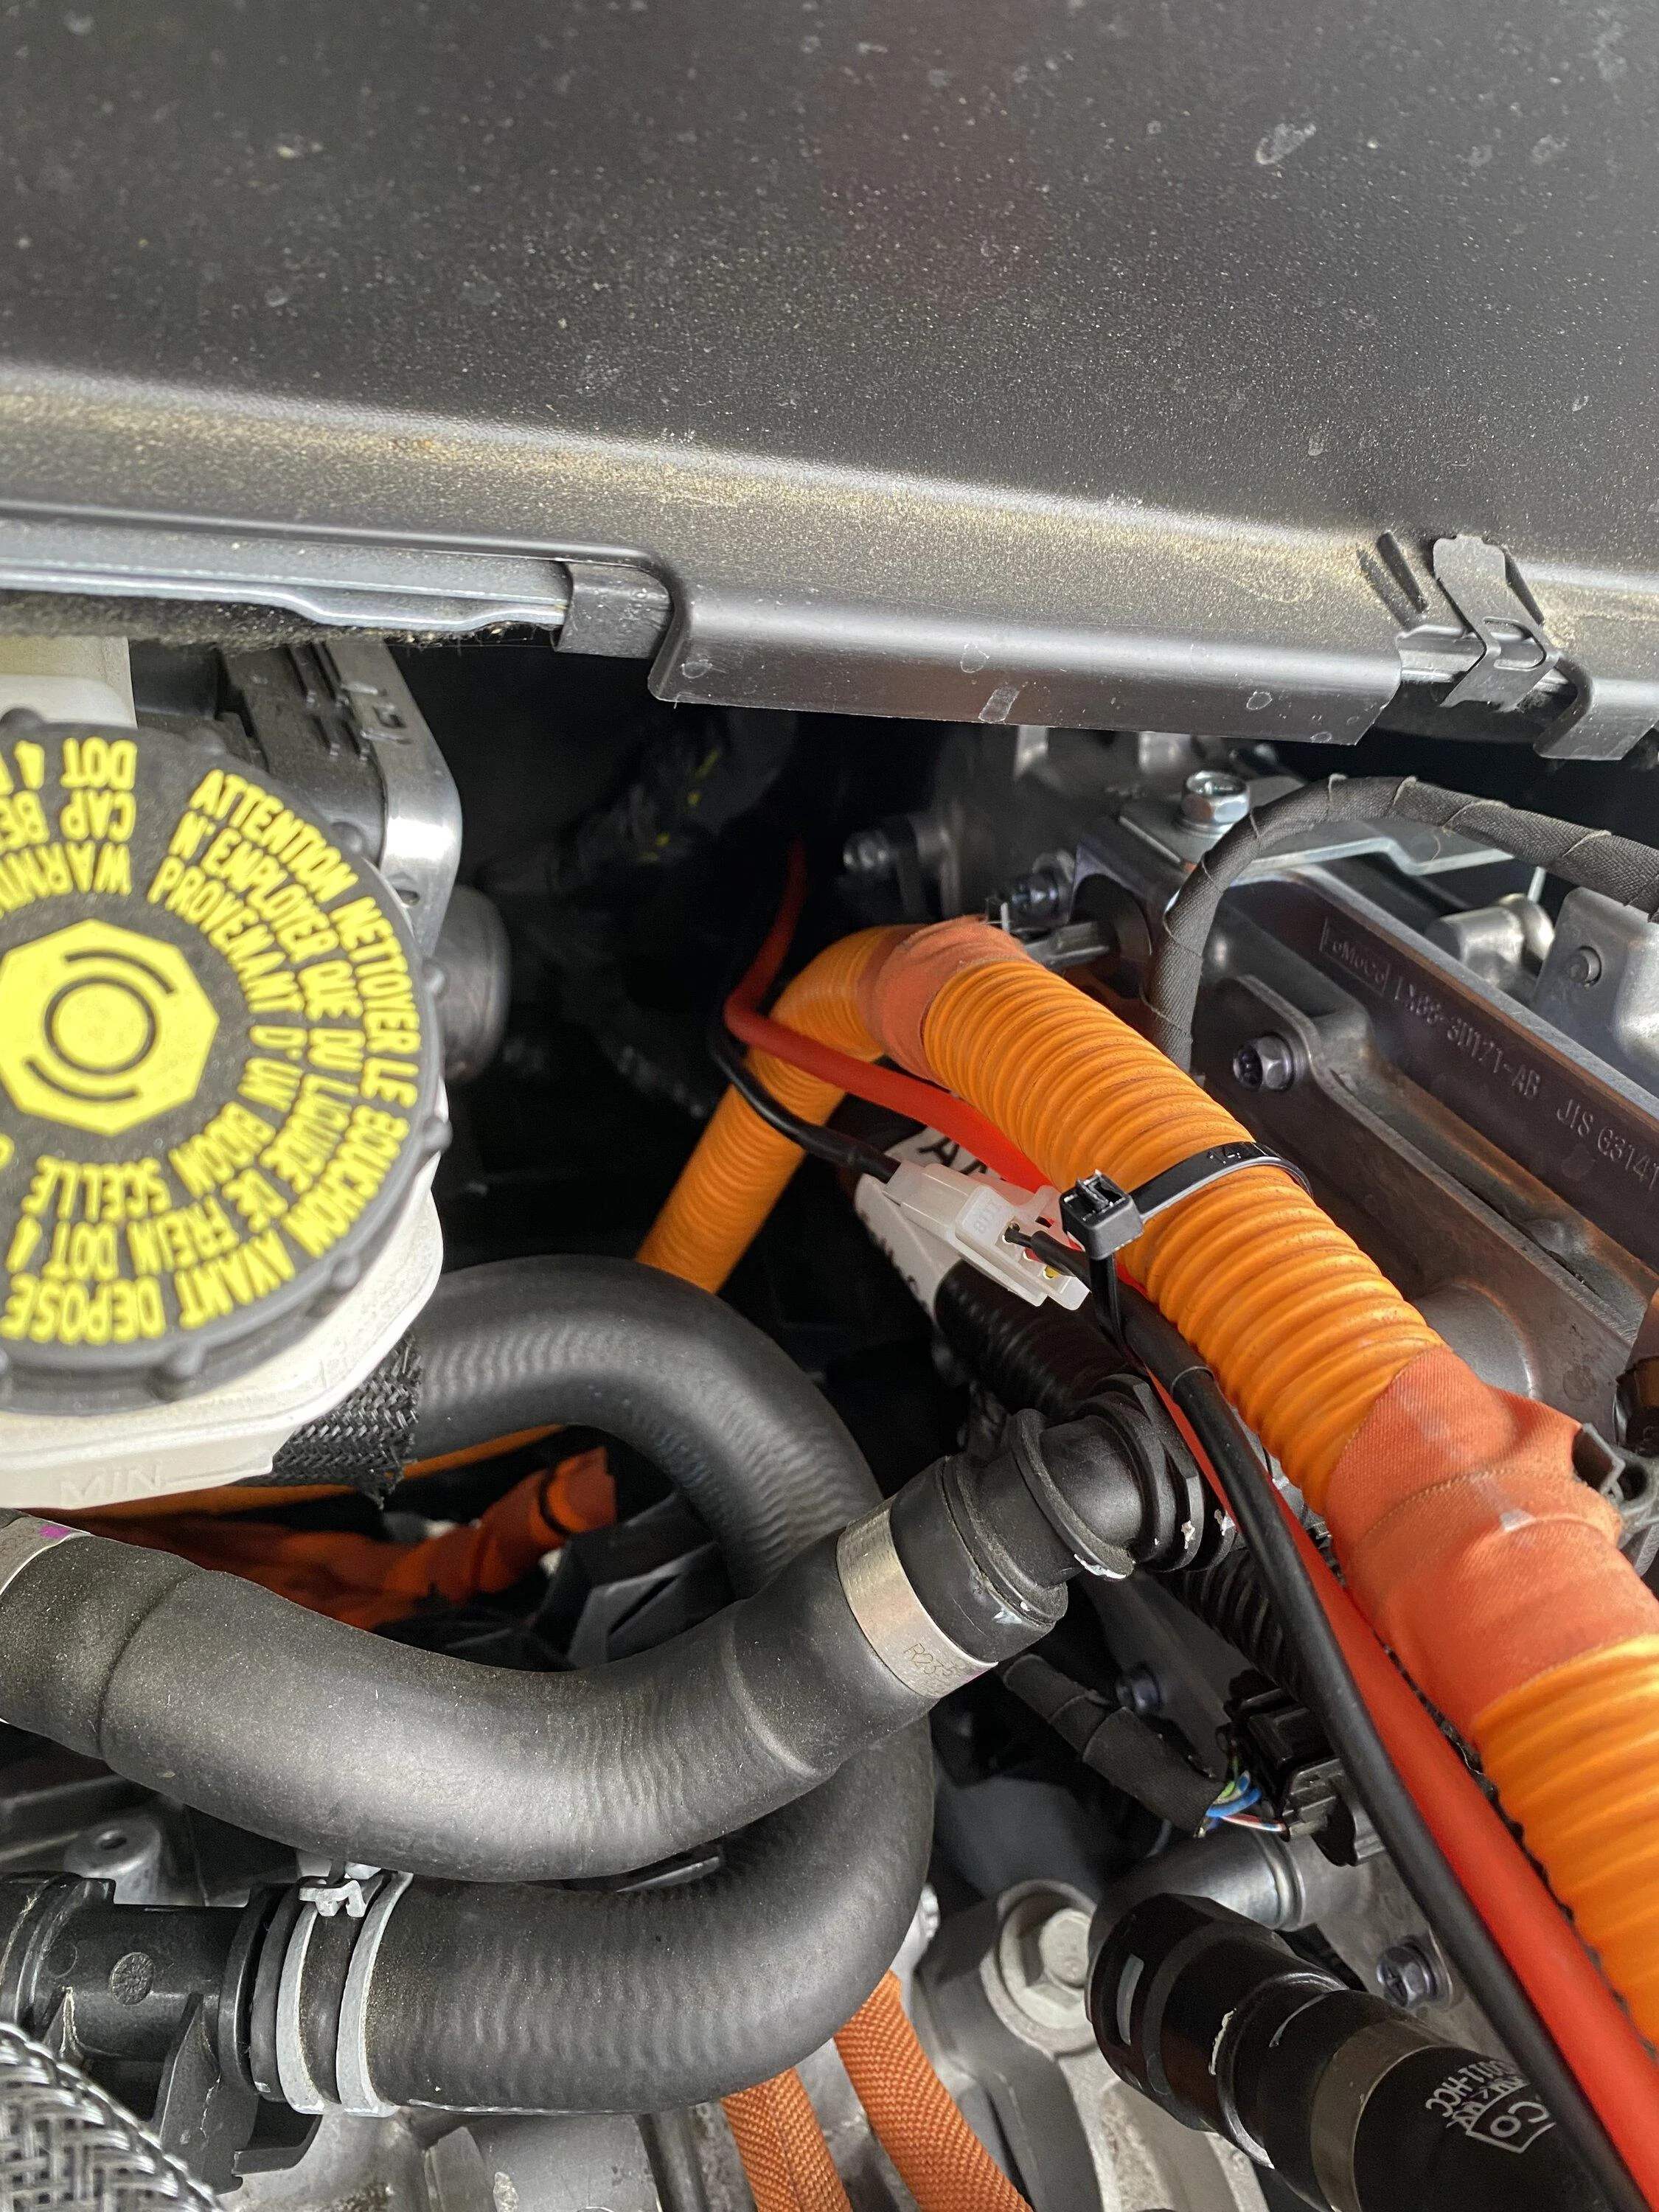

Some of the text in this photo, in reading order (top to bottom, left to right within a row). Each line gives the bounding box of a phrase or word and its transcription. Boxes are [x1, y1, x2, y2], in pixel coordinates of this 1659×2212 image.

[13, 740, 45, 790] 4
[60, 737, 138, 791] DOT
[60, 789, 138, 842] CAP
[147, 855, 305, 1013] PROVENANT
[298, 960, 364, 1021] QUE
[0, 769, 421, 1346] ATTENTION NETTOYER LE BOUCHON AVANT DEPOSE
[307, 1027, 366, 1073] DU
[260, 1074, 359, 1194] LIQUIDE
[1557, 1099, 1595, 1137] JIS
[168, 1101, 276, 1198] BIDON
[21, 1155, 173, 1222] SCELLE
[222, 1168, 288, 1233] DE
[42, 1220, 119, 1281] DOT
[127, 1194, 240, 1277] FREIN
[60, 1459, 164, 1506] MIN
